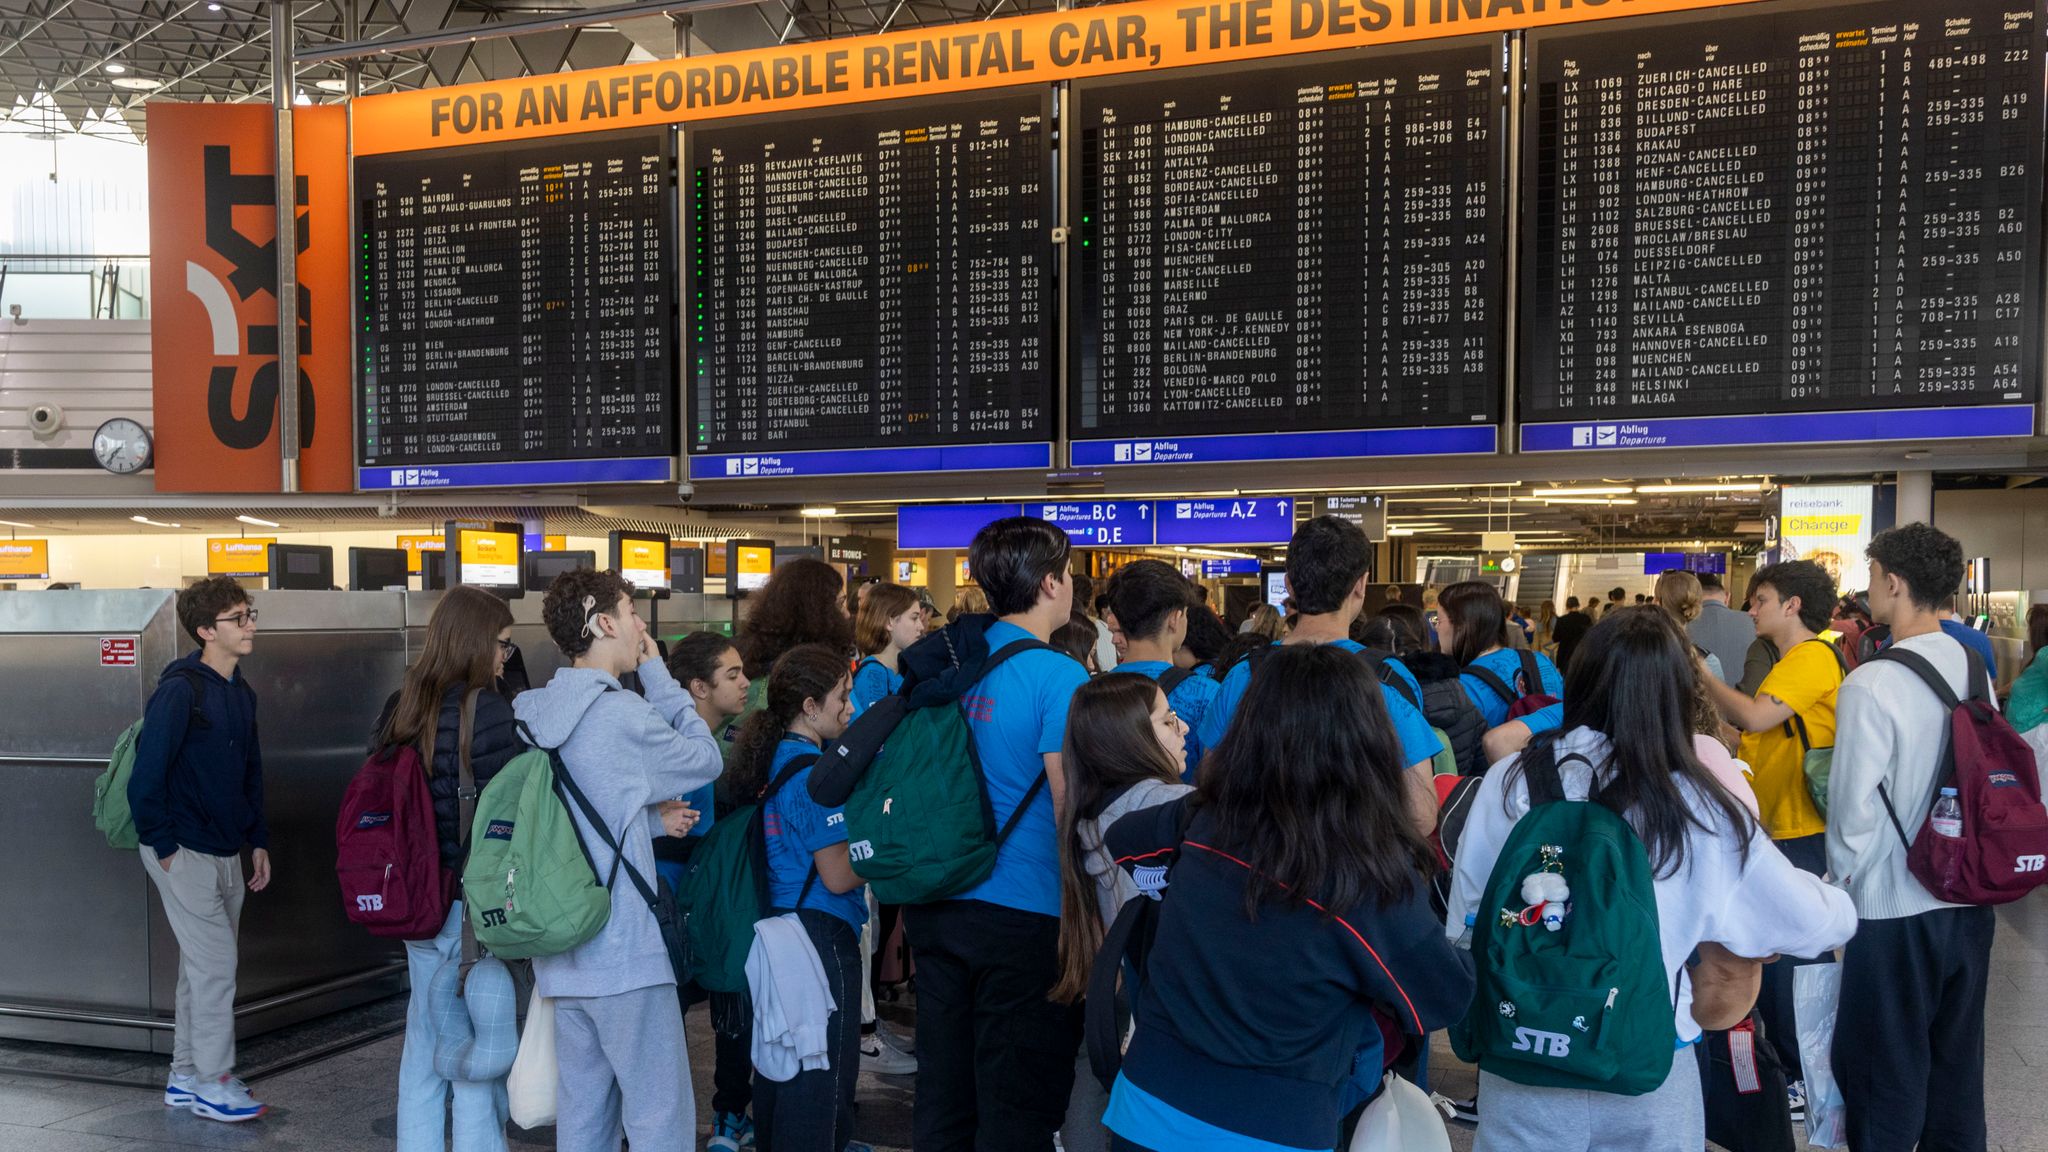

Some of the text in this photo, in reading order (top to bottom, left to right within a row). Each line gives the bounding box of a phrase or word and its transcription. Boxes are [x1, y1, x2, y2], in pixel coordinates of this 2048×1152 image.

[1871, 25, 1896, 36] Terminal
[1945, 17, 1972, 29] Schalter
[2004, 11, 2033, 24] Flugsteig
[1871, 34, 1897, 45] Terminal
[1945, 27, 1970, 37] Counter
[2004, 22, 2020, 32] Gate
[431, 93, 505, 137] FOR
[514, 86, 569, 129] AN
[580, 52, 850, 121] AFFORDABLE
[863, 29, 1032, 90] RENTAL
[1049, 15, 1161, 67] CAR,
[1176, 0, 1272, 52] THE
[1637, 62, 1766, 85] ZUERICH-CANCELLED
[1564, 94, 1578, 105] UA
[1600, 90, 1622, 102] 945
[1637, 82, 1705, 98] CHICAGO-O
[1712, 78, 1743, 91] HARE
[1903, 62, 1911, 74] B
[1928, 55, 1987, 71] 489-498
[2003, 51, 2030, 64] Z22
[1637, 90, 1766, 112] DRESDEN-CANCELLED
[1164, 112, 1271, 132] HAMBURG-CANCELLED
[1636, 104, 1765, 126] BILLUND-CANCELLED
[1164, 125, 1265, 144] LONDON-CANCELLED
[1636, 124, 1696, 139] BUDAPEST
[1164, 143, 1214, 156] HURGHADA
[1636, 138, 1681, 153] KRAKAU
[1164, 155, 1208, 169] ANTALYA
[1636, 146, 1757, 166] POZNAN-CANCELLED
[1164, 162, 1271, 181] FLORENZ-CANCELLED
[1636, 161, 1741, 179] HENF-CANCELLED
[1164, 174, 1277, 193] BORDEAUX-CANCELLED
[1635, 173, 1764, 193] HAMBURG-CANCELLED
[1164, 188, 1258, 206] SOFIA-CANCELLED
[1635, 187, 1748, 206] LONDON-HEATHROW
[766, 205, 797, 216] DUBLIN
[1164, 204, 1220, 218] AMSTERDAM
[1635, 199, 1771, 220] SALZBURG-CANCELLED
[1164, 212, 1271, 230] PALMA DE MALLORCA
[1635, 213, 1770, 233] BRUESSEL-CANCELLED
[1164, 228, 1233, 242] LONDON-CITY
[1634, 228, 1747, 246] WROCLAW/BRESLAU
[766, 238, 808, 250] BUDAPEST
[1164, 239, 1251, 254] PISA-CANCELLED
[1634, 244, 1716, 260] DUESSELDORF
[1164, 254, 1214, 267] MUENCHEN
[1634, 255, 1762, 273] LEIPZIG-CANCELLED
[1164, 263, 1251, 279] WIEN-CANCELLED
[1164, 278, 1220, 291] MARSEILLE
[1634, 274, 1671, 286] MALTA
[186, 145, 316, 449] SIXT
[1164, 291, 1207, 303] PALERMO
[1635, 281, 1768, 299] ISTANBUL-CANCELLED
[1164, 305, 1189, 315] GRAZ
[1633, 295, 1760, 313] MAILAND-CANCELLED
[766, 317, 809, 328] WARSCHAU
[1561, 332, 1574, 343] XQ
[1597, 330, 1618, 341] 793
[1633, 327, 1677, 339] ANKARA
[1684, 323, 1745, 336] ESENBOGA
[1894, 314, 1902, 325] C
[1919, 310, 1977, 324] 708-711
[1993, 308, 2019, 320] C17
[1633, 313, 1685, 326] SEVILLA
[1164, 323, 1289, 340] NEW YORK-J.F.KENNEDY
[1632, 335, 1767, 352] HANNOVER-CANCELLED
[767, 351, 814, 362] BARCELONA
[1164, 348, 1276, 364] BERLIN-BRANDENBURG
[1632, 352, 1691, 365] MUENCHEN
[1164, 364, 1207, 376] BOLOGNA
[1632, 363, 1759, 379] MAILAND-CANCELLED
[767, 374, 793, 384] NIZZA
[1164, 373, 1276, 388] VENEDIG-MARCO POLO
[1632, 379, 1689, 392] HELSINKI
[1164, 397, 1282, 412] KATTOWITZ-CANCELLED
[1632, 393, 1676, 405] MALAGA
[768, 418, 809, 429] ISTANBUL
[1620, 424, 1649, 435] Abflug
[767, 431, 787, 440] BARI
[1620, 435, 1667, 446] Departures
[1154, 442, 1179, 451] Abflug
[760, 457, 782, 466] Abflug
[1154, 451, 1194, 461] Departures
[420, 469, 439, 478] Abflug
[760, 465, 794, 475] Departures
[420, 478, 450, 487] Departures
[1059, 505, 1080, 514] Abflug
[1193, 502, 1215, 511] Abflug
[1230, 501, 1257, 518] A,Z
[1789, 499, 1842, 508] reisebank
[1092, 504, 1117, 521] B,C
[1789, 519, 1848, 533] Change
[1097, 527, 1122, 544] D,E
[225, 543, 263, 552] Lufthansa
[850, 839, 874, 862] STB
[2014, 854, 2046, 873] STB
[357, 894, 384, 912] STB
[481, 908, 508, 928] STB
[1512, 1026, 1571, 1058] STB
